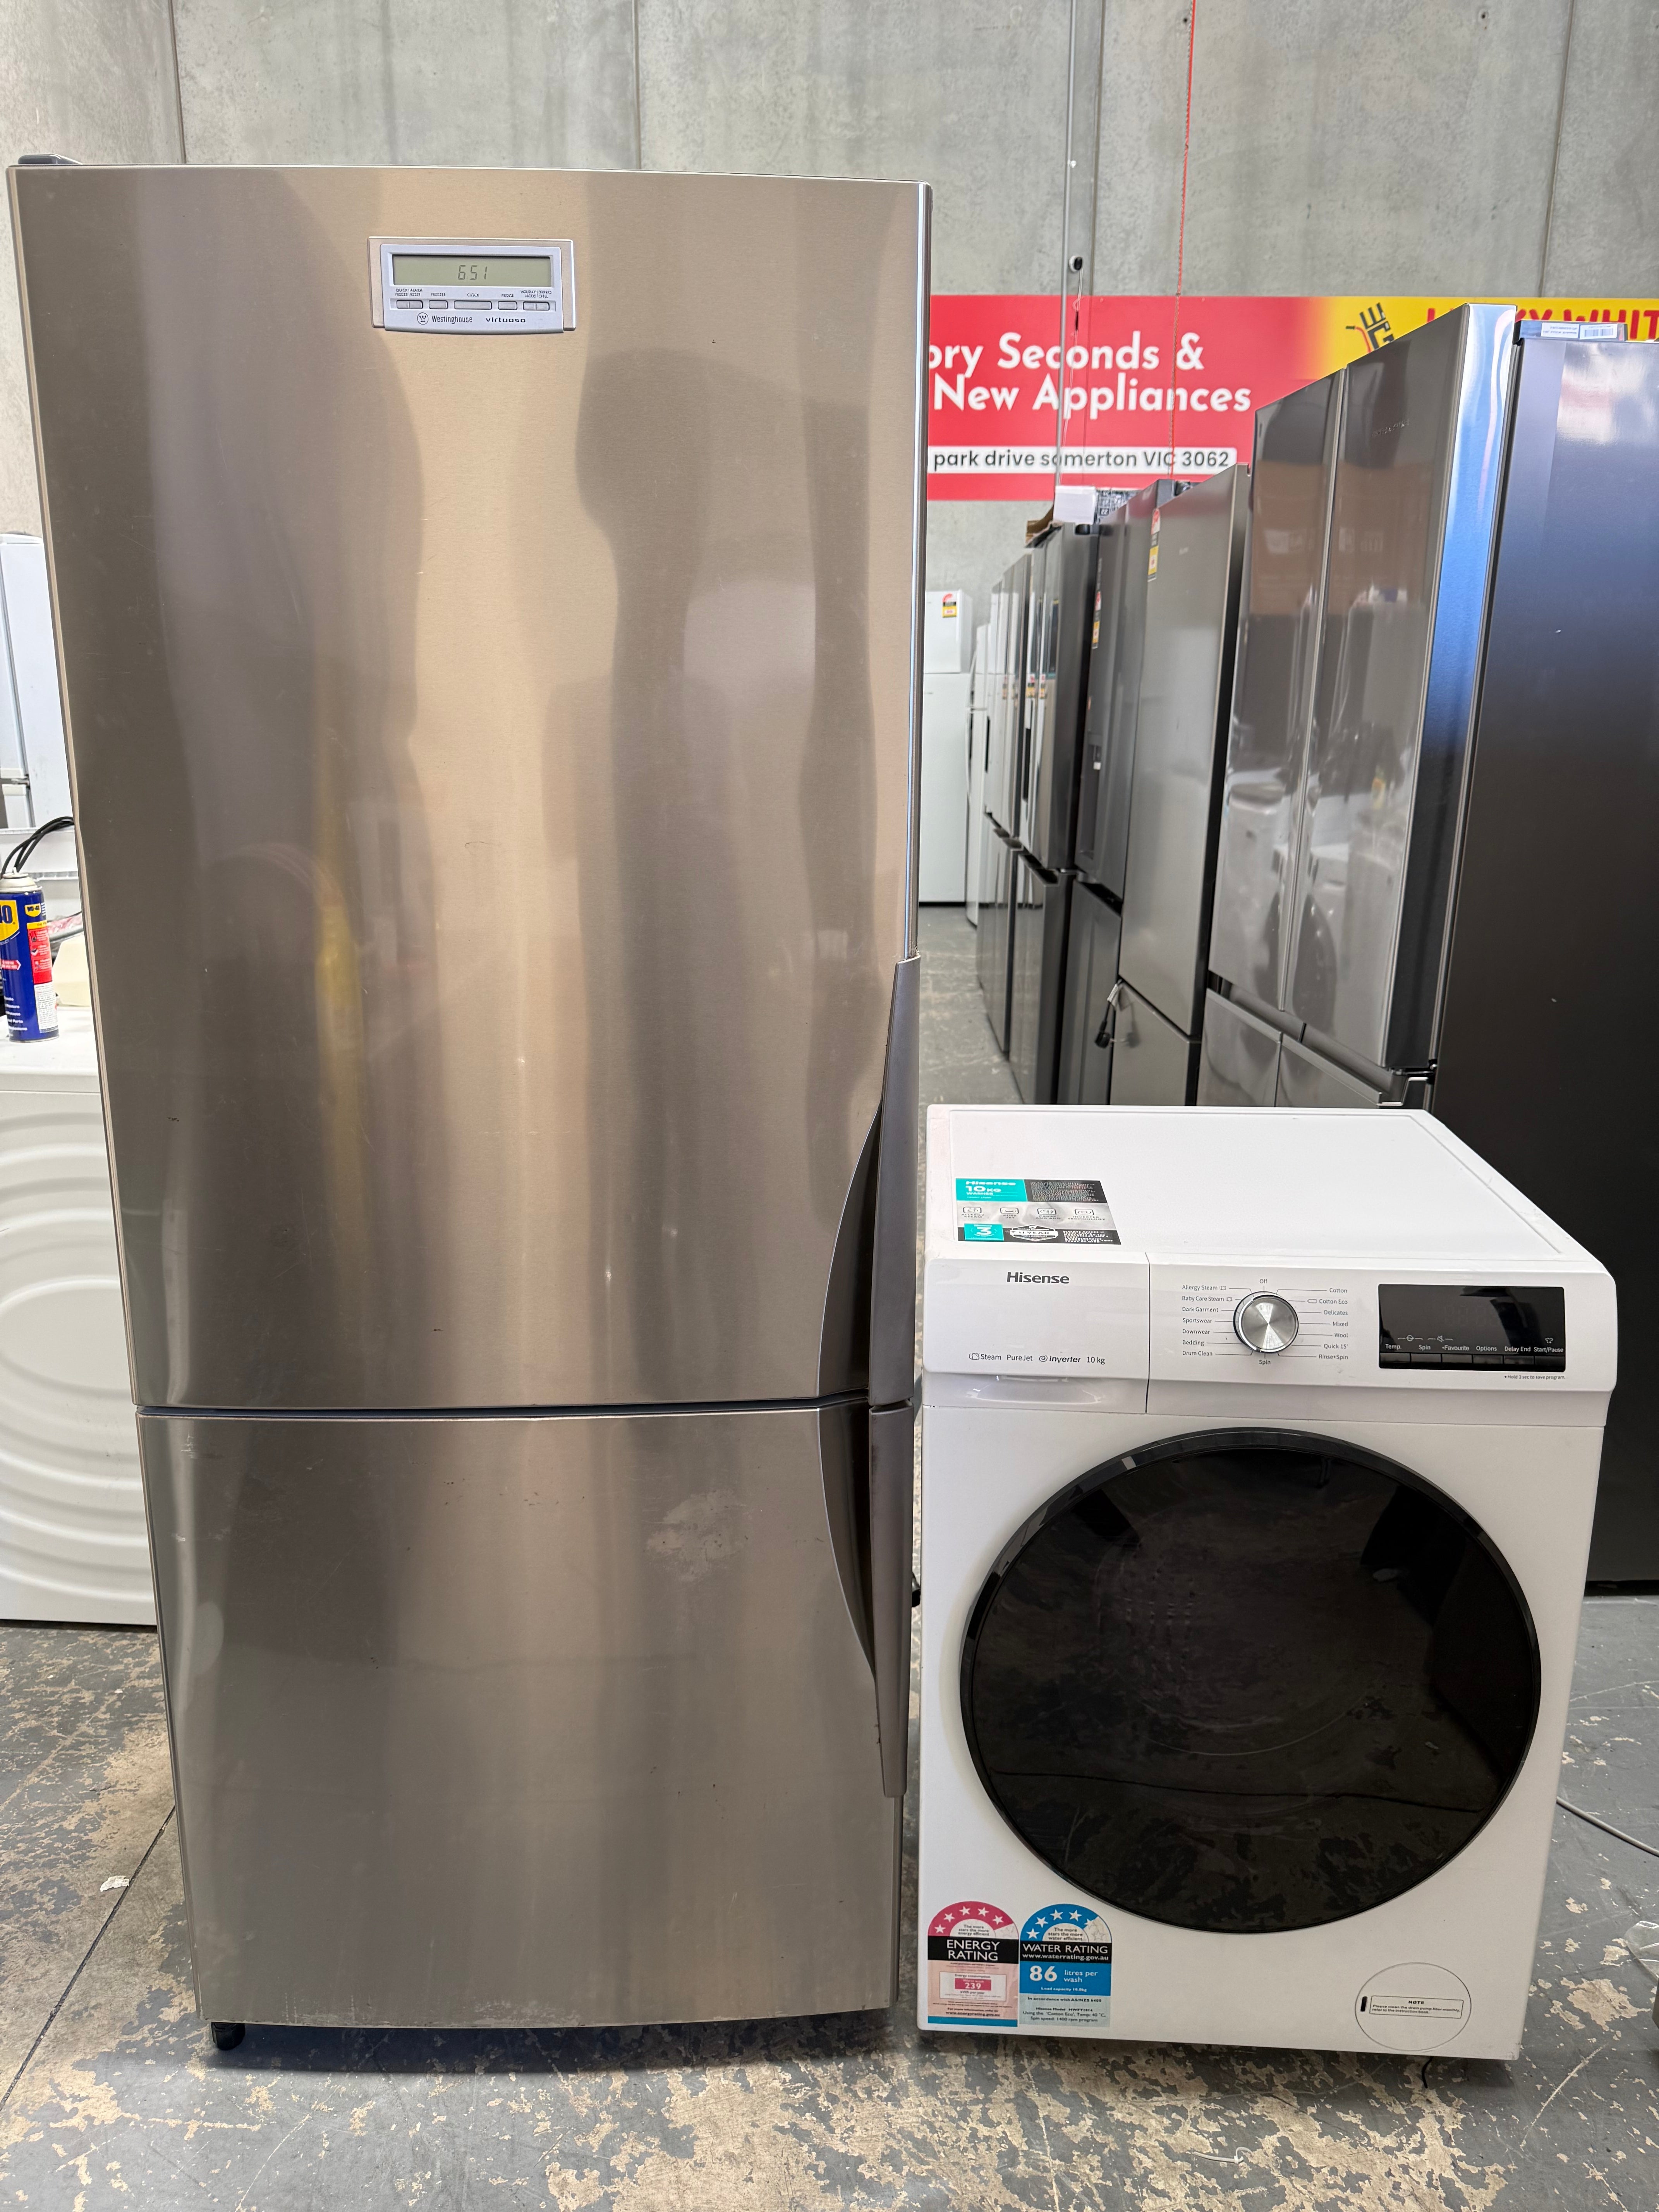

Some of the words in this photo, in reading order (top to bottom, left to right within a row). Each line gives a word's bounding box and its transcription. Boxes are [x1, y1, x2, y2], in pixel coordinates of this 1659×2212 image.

[432, 316, 472, 324] Westinghouse
[997, 330, 1159, 370] Seconds
[1176, 332, 1204, 370] &
[934, 373, 1020, 411] New
[1032, 372, 1251, 420] Appliances
[934, 450, 979, 472] park
[985, 450, 1035, 466] drive
[1041, 452, 1137, 467] somerton
[1144, 452, 1176, 466] VIC
[1182, 451, 1228, 467] 3062
[1007, 1272, 1070, 1284] Hisense
[1049, 1355, 1080, 1364] inverter
[1097, 1357, 1105, 1365] kg
[947, 1939, 1000, 1951] ENERGY
[1023, 1944, 1061, 1953] WATER
[1065, 1945, 1108, 1954] RATING
[948, 1950, 998, 1961] RATING
[1030, 1965, 1057, 1982] 86
